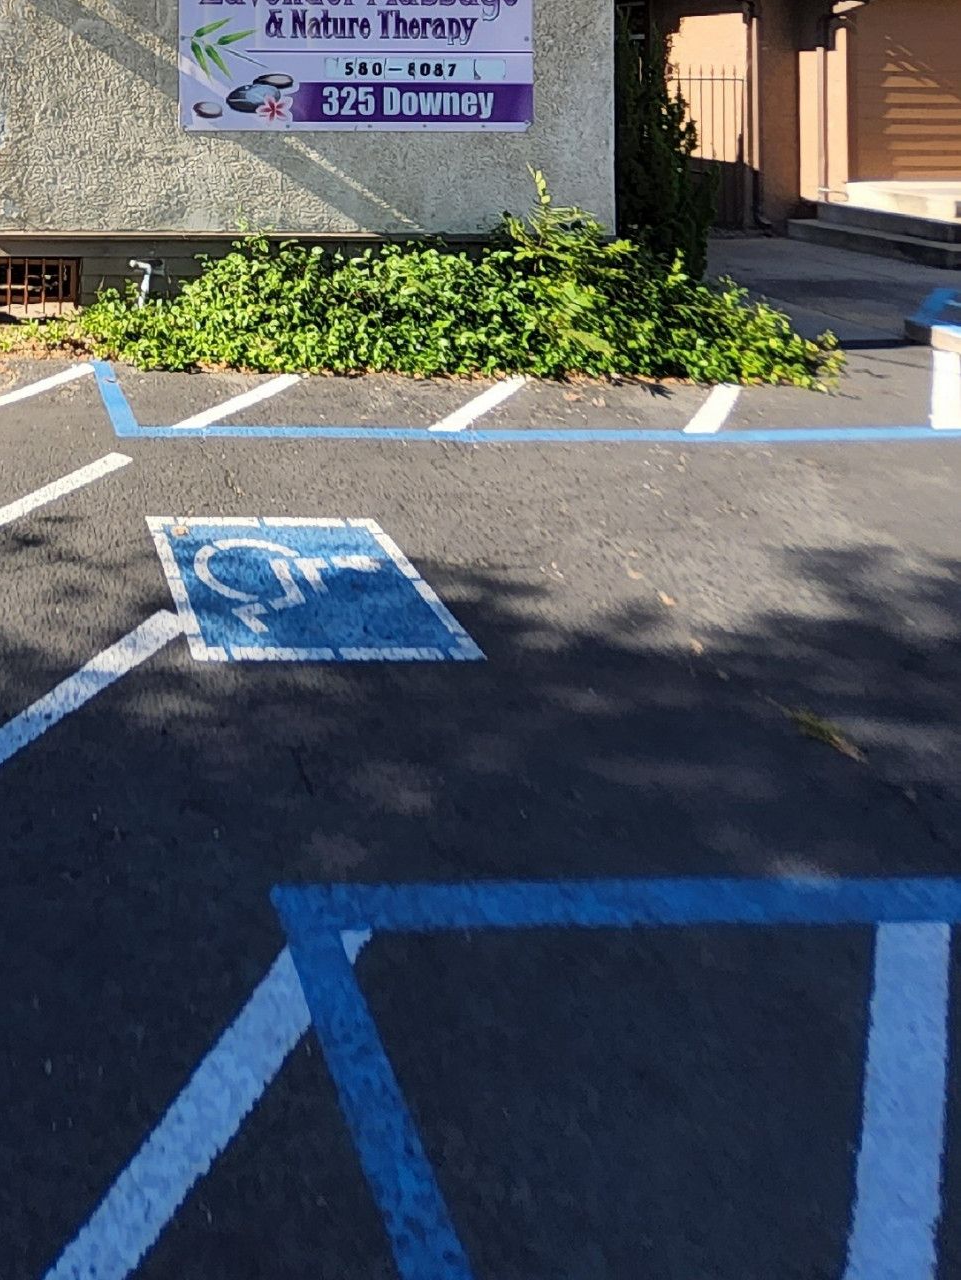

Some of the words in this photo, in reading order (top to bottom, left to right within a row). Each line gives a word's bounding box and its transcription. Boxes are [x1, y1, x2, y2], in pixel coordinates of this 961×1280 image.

[265, 9, 287, 39] &
[291, 9, 372, 40] Nature
[377, 9, 479, 46] Therapy
[322, 86, 376, 117] 325
[383, 86, 495, 119] Downey
